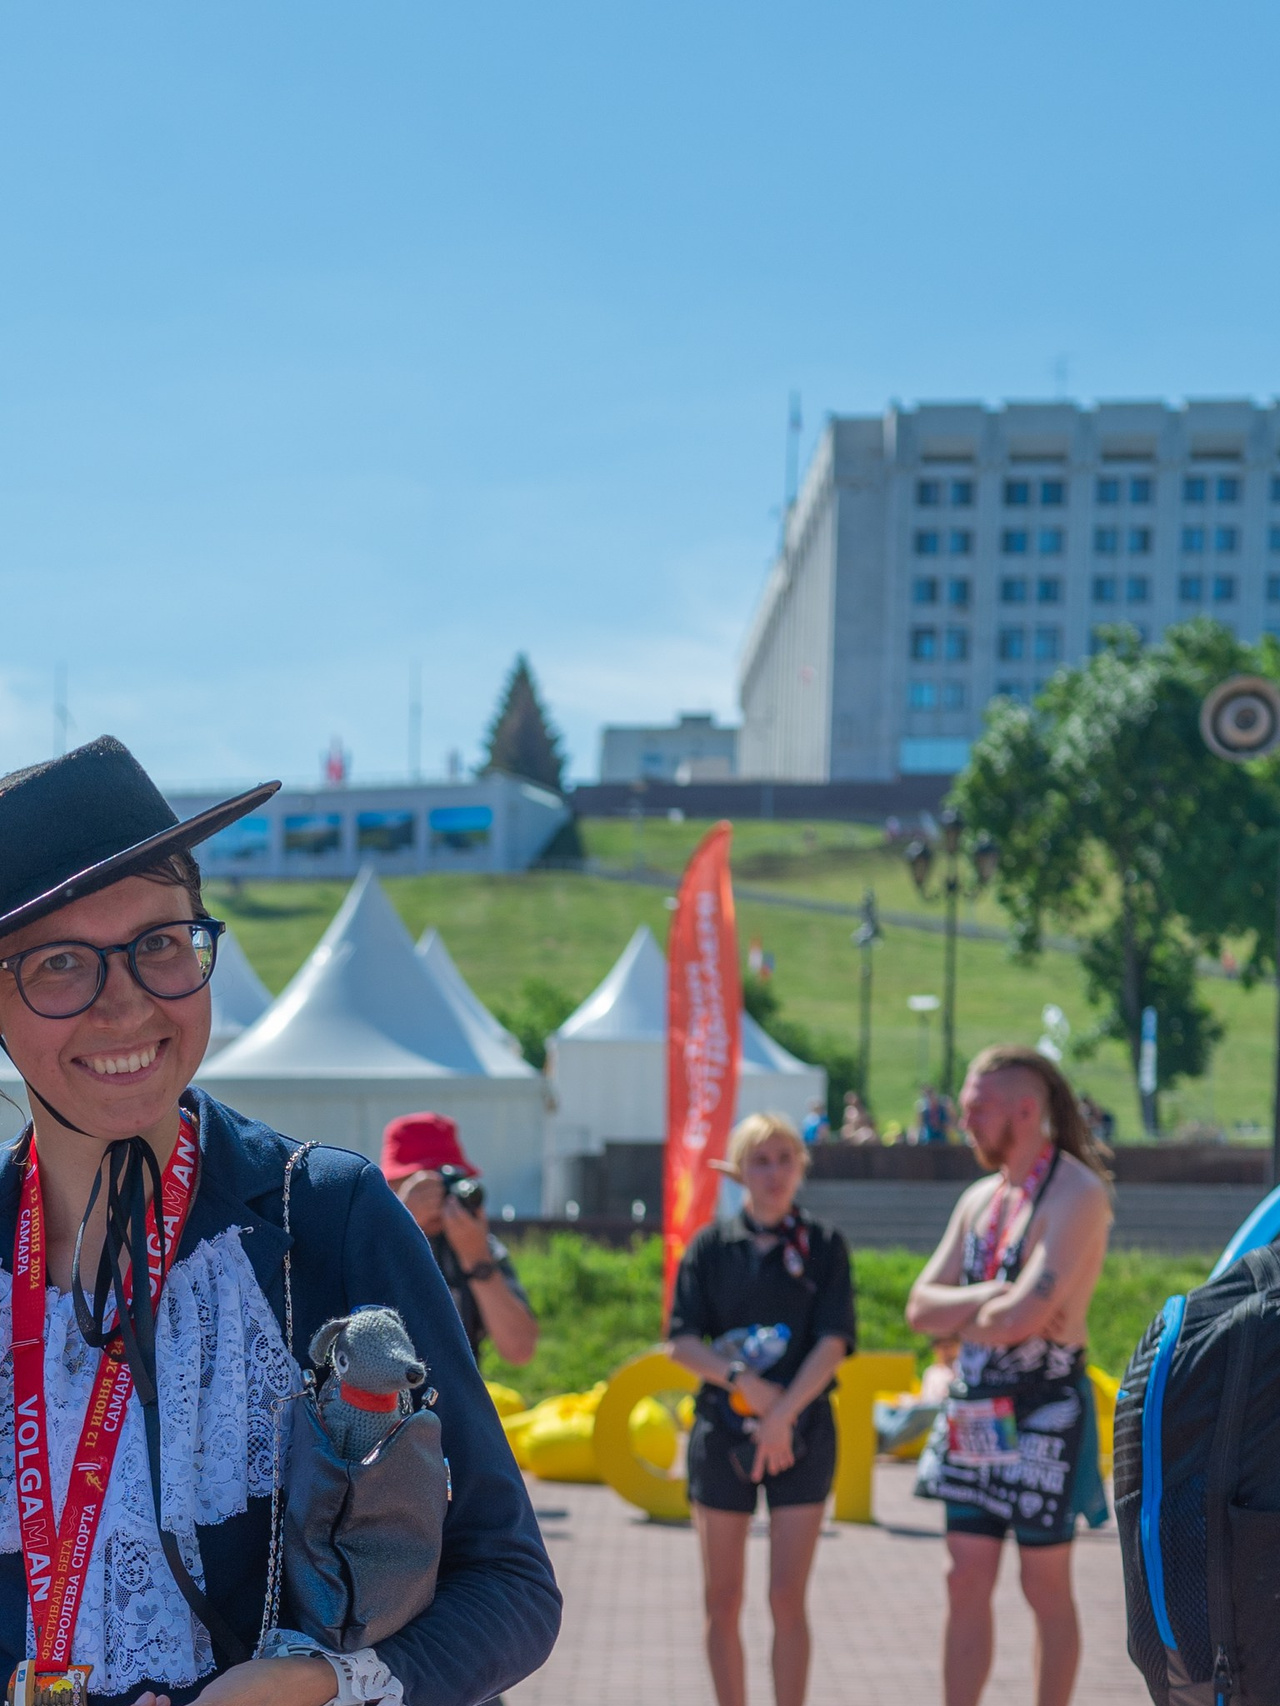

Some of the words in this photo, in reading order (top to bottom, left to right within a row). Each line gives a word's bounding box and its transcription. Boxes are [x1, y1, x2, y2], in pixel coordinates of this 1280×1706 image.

[30, 1186, 38, 1203] 12
[17, 1208, 31, 1276] САМАРА
[31, 1206, 40, 1253] ИЮНЯ
[30, 1256, 41, 1290] 2024
[90, 1376, 114, 1427] ИЮНЯ
[84, 1431, 99, 1448] 12
[18, 1394, 51, 1602] VOLGAMAN
[41, 1575, 66, 1660] ФЕСТИВАЛЬ
[57, 1538, 74, 1572] БЕГА
[52, 1574, 81, 1662] КОРОЛЕВА
[71, 1503, 97, 1569] СПОРТА
